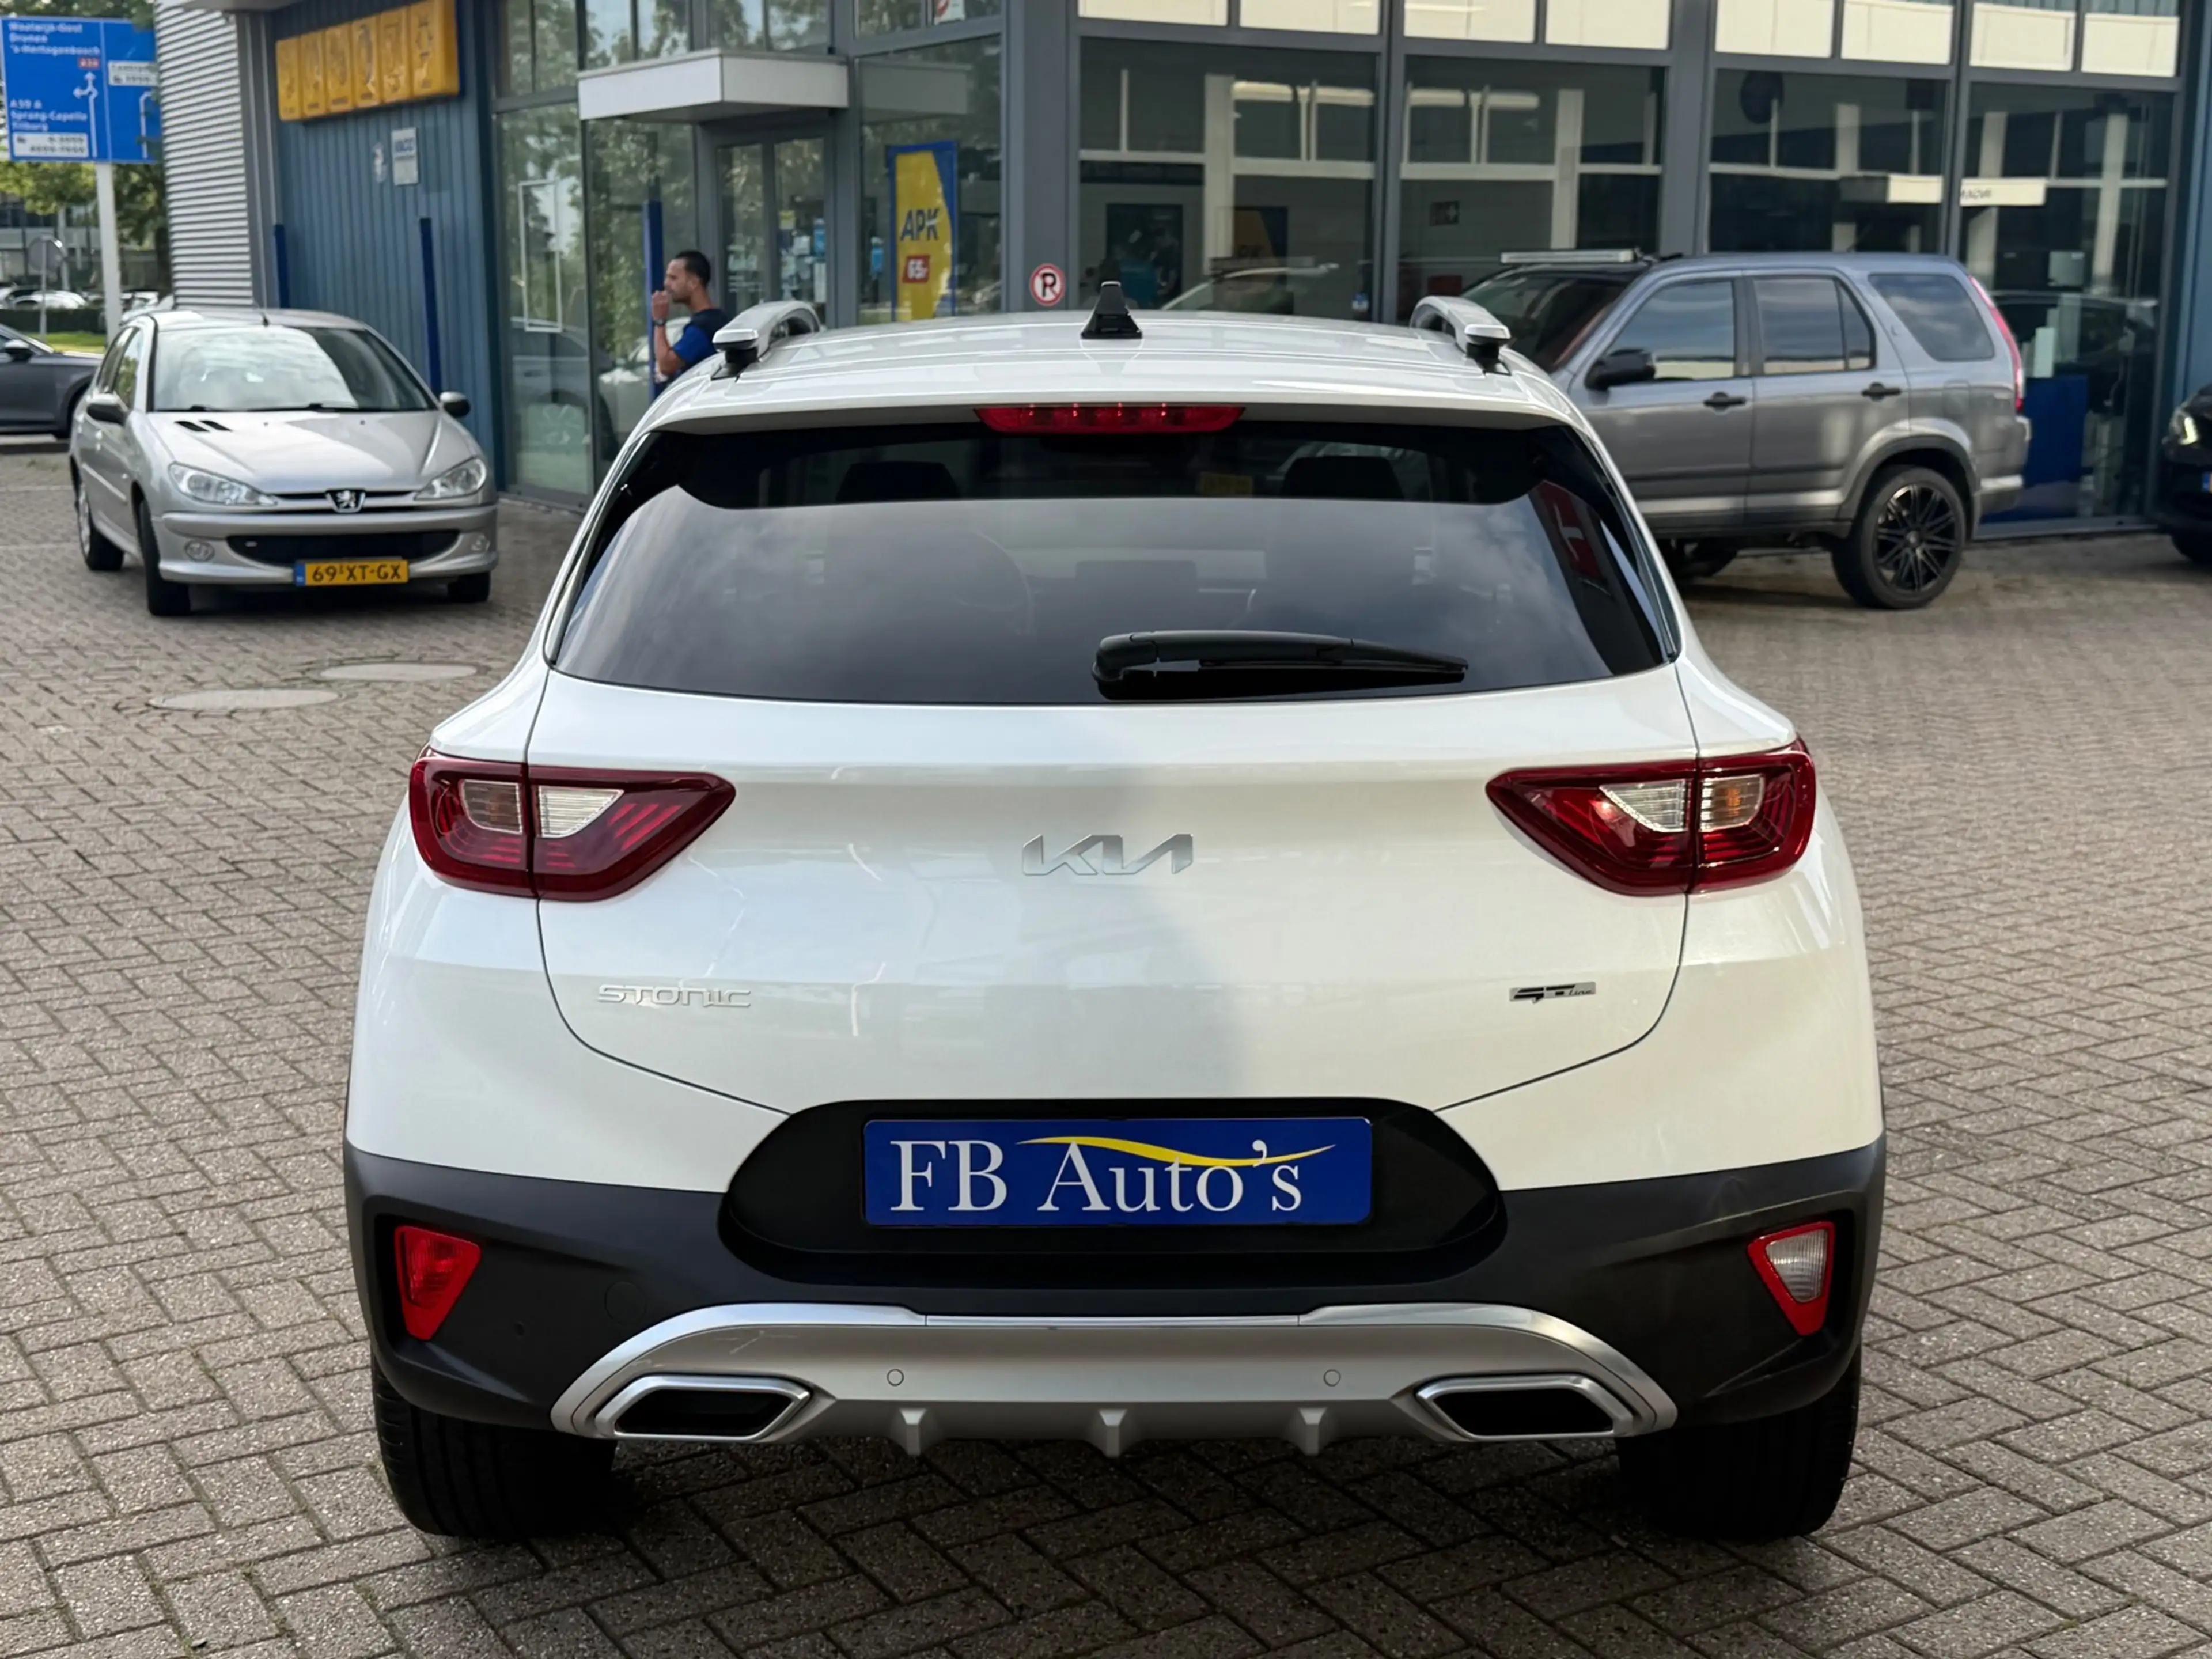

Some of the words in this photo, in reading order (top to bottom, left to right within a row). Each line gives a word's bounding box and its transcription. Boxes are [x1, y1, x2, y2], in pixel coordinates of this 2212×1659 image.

[900, 207, 940, 241] APK
[1022, 834, 1193, 876] KIA
[597, 984, 751, 1008] STONIC
[890, 1139, 1007, 1211] FB
